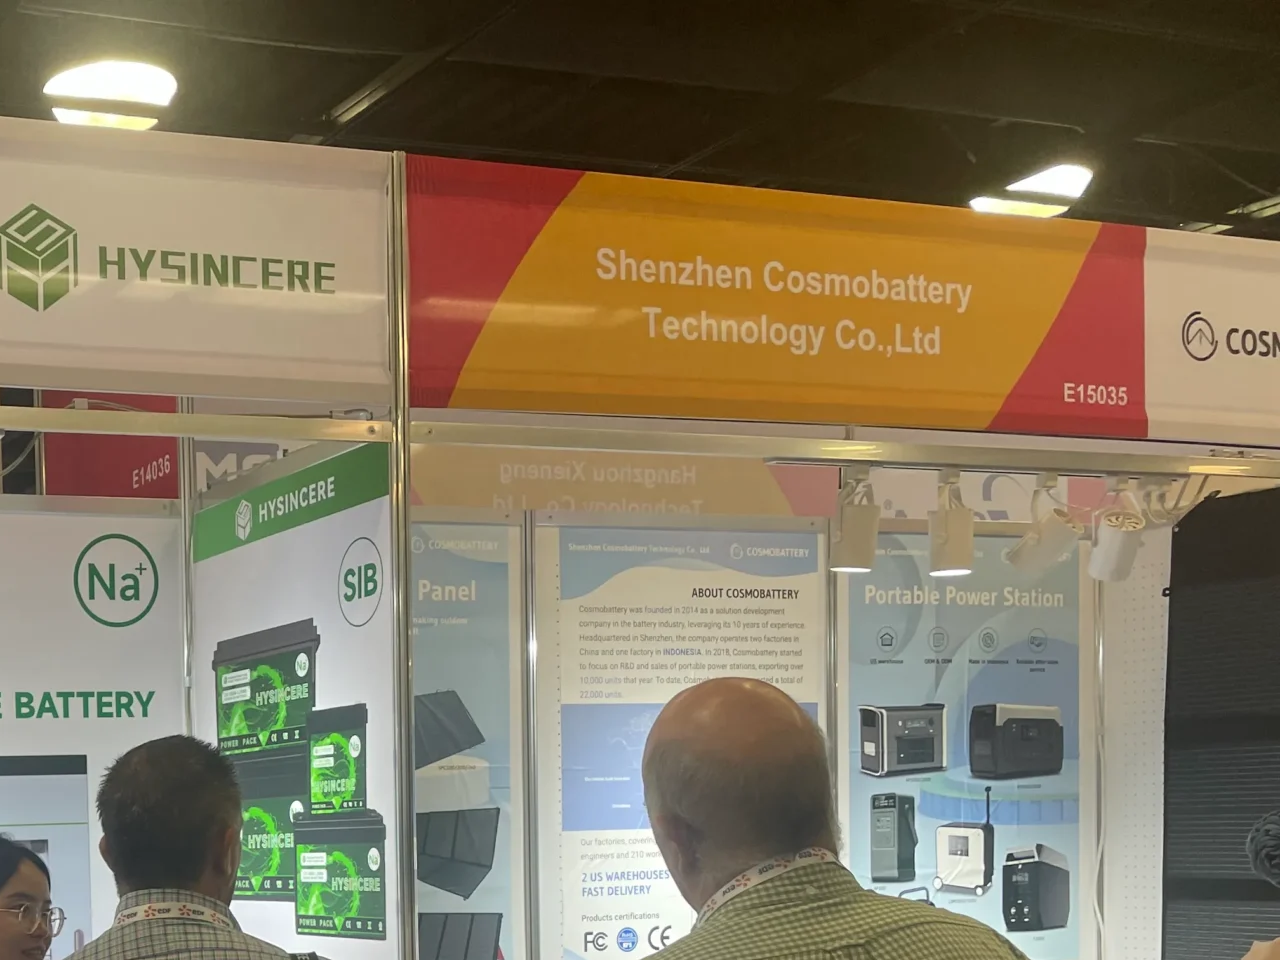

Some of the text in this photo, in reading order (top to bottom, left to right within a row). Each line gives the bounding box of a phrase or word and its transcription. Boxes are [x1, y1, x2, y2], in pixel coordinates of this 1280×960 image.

[98, 246, 336, 295] HYSINCERE
[596, 246, 973, 313] Shenzhen Cosmobattery
[642, 306, 941, 358] Technology Co.,Ltd
[1063, 382, 1129, 406] E15035
[132, 455, 170, 489] E14036
[258, 476, 336, 523] HYSINCERE
[747, 548, 809, 558] COSMOBATTERY
[343, 562, 378, 602] SIB
[418, 579, 476, 601] Panel
[692, 588, 799, 600] ABOUT COSMOBATTERY
[865, 584, 1064, 607] Portable Power Station
[579, 605, 627, 615] Cosmobattery
[645, 606, 672, 614] founded
[682, 606, 698, 614] 2014
[743, 607, 785, 616] development
[579, 621, 611, 629] company
[633, 620, 656, 630] battery
[688, 621, 721, 631] leveraging
[743, 622, 760, 630] years
[579, 634, 630, 642] Headquartered
[688, 635, 718, 643] company
[720, 635, 748, 643] operates
[579, 648, 599, 656] China
[601, 648, 614, 656] and
[630, 648, 653, 657] factory
[733, 648, 777, 657] Cosmobattery
[579, 662, 587, 670] to
[588, 662, 608, 670] focus
[620, 662, 634, 670] R&D
[636, 662, 649, 670] and
[651, 662, 668, 670] sales
[670, 662, 677, 670] of
[678, 662, 705, 671] portable
[708, 663, 728, 671] power
[758, 663, 789, 671] exporting
[256, 683, 309, 706] HYSINCERE
[14, 690, 156, 719] BATTERY
[242, 735, 257, 746] PACK
[580, 853, 615, 861] engineers
[616, 851, 629, 859] and
[582, 870, 670, 882] 2 US WAREHOUSES
[332, 877, 381, 892] HYSINCERE
[582, 885, 651, 897] FAST DELIVERY
[299, 918, 333, 927] POWER PACK
[581, 911, 660, 922] Products certifications
